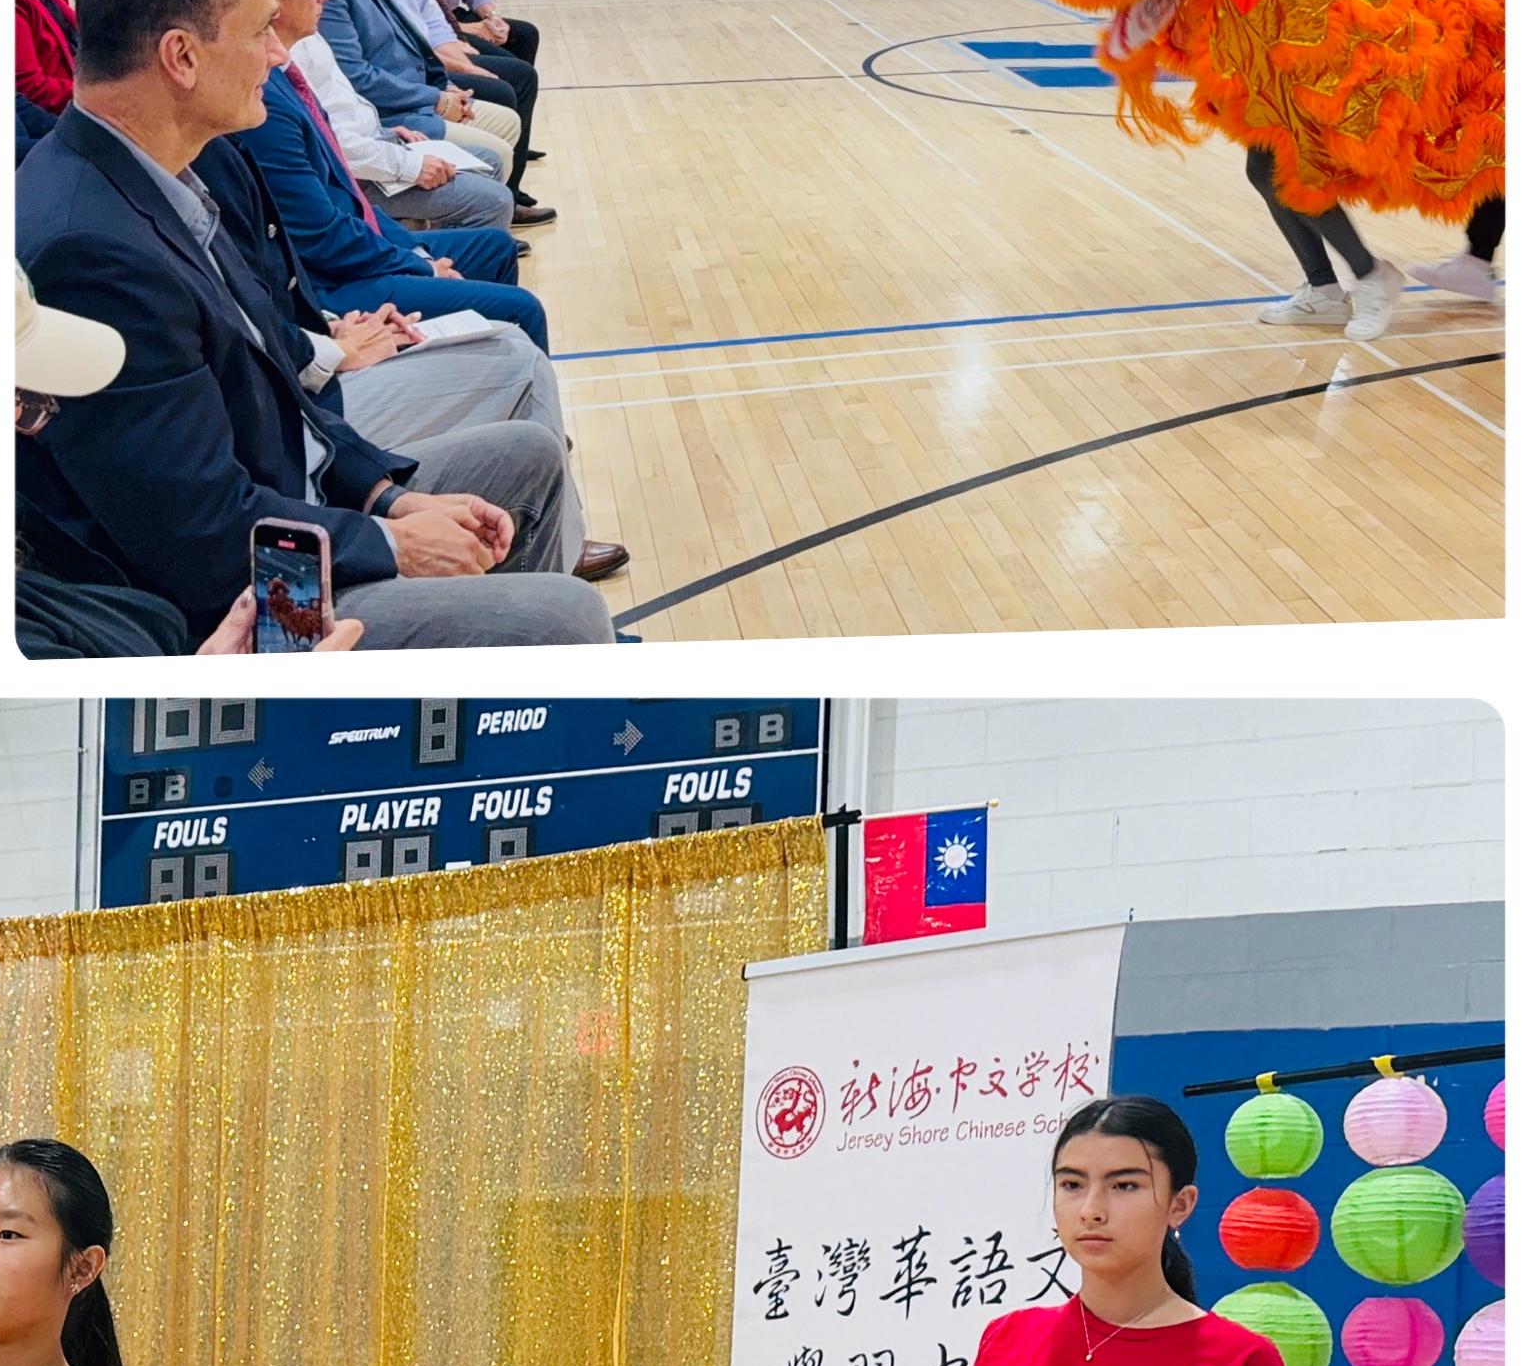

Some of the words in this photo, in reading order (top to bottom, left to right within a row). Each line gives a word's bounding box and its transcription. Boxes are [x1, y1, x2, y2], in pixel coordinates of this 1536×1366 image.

[477, 707, 547, 735] PERIOD
[663, 766, 754, 805] FOULS
[340, 796, 442, 834] PLAYER
[469, 785, 554, 822] FOULS
[153, 816, 229, 850] FOULS
[837, 1129, 894, 1152] Jersey
[899, 1125, 950, 1146] Shore
[956, 1117, 1026, 1141] Chinese
[1033, 1112, 1069, 1135] Sch
[753, 1224, 1076, 1322] 臺灣華語文
